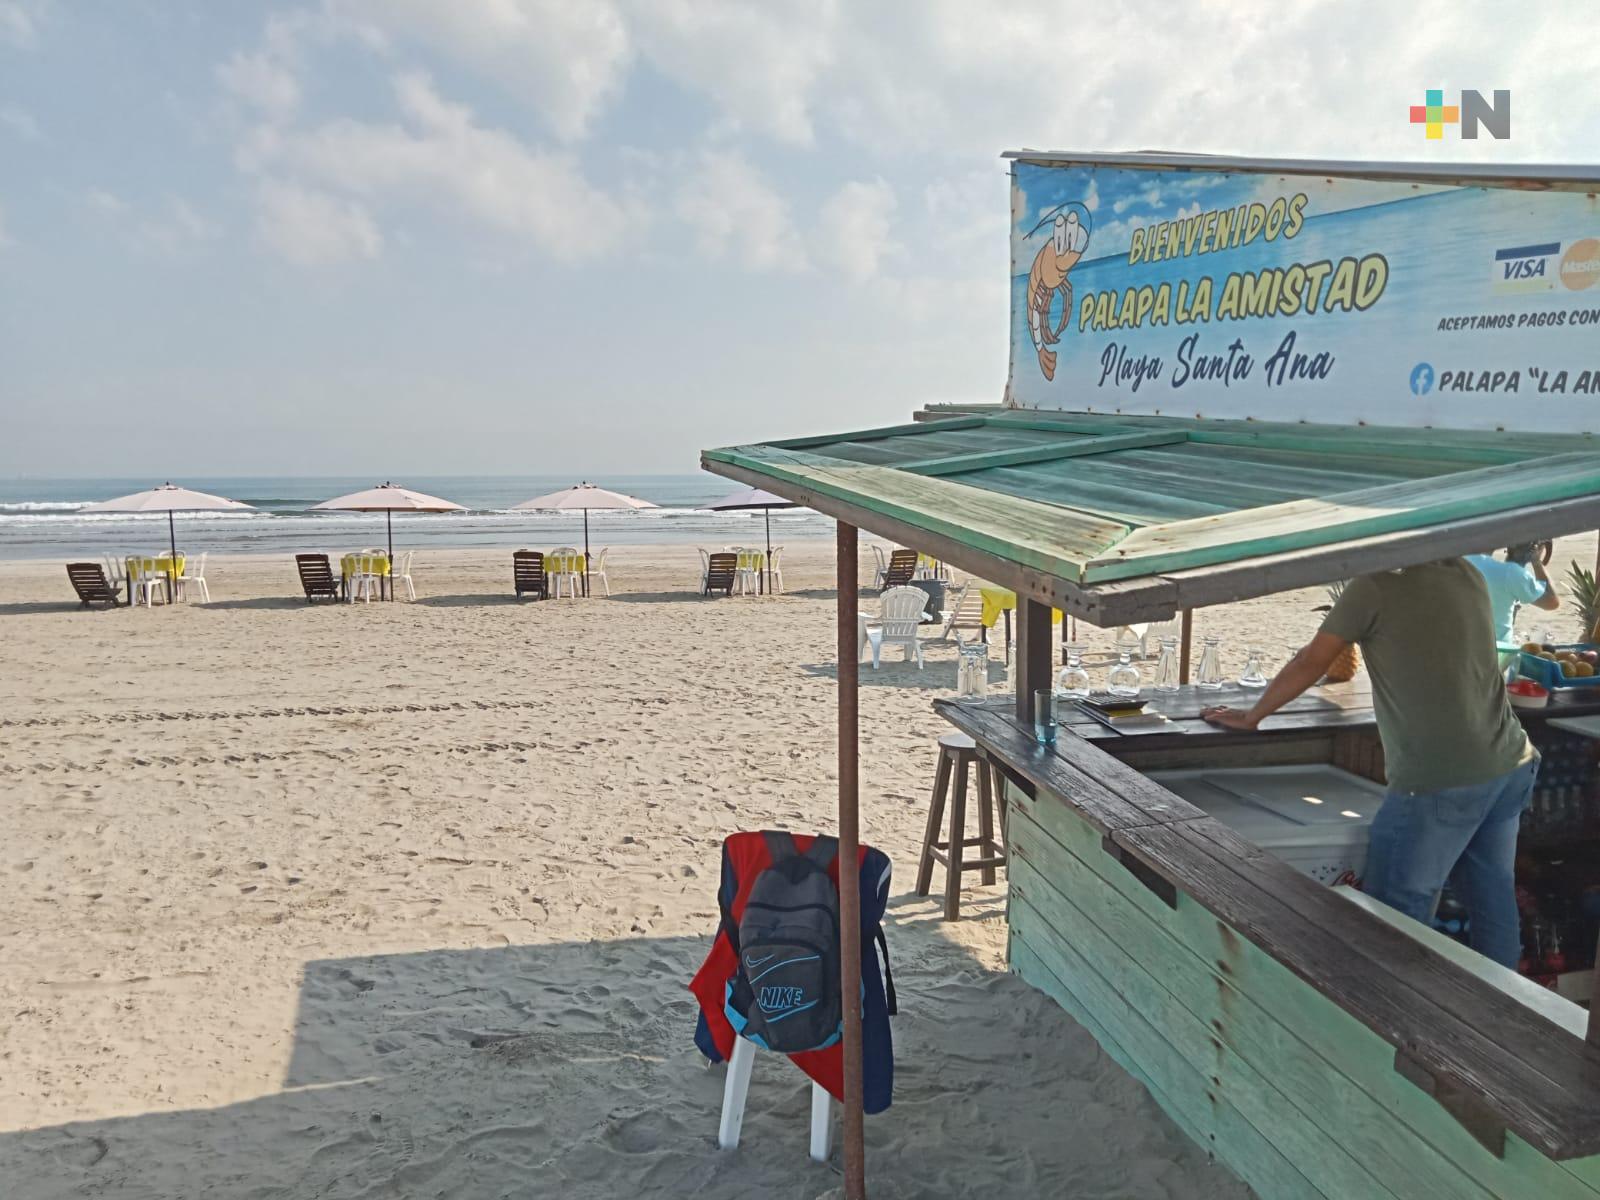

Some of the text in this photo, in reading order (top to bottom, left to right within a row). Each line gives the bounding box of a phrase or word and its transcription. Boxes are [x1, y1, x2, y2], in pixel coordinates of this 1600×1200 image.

[1128, 192, 1308, 265] BIENVENIDOS
[1503, 258, 1546, 280] VISA
[1078, 253, 1390, 333] PALAPA LA AMISTAD
[1437, 309, 1600, 331] ACEPTAMOS PAGOS CON
[1098, 330, 1336, 392] Playa Santa Ana
[1438, 371, 1520, 393] PALAPA
[760, 986, 803, 1009] NIKE
